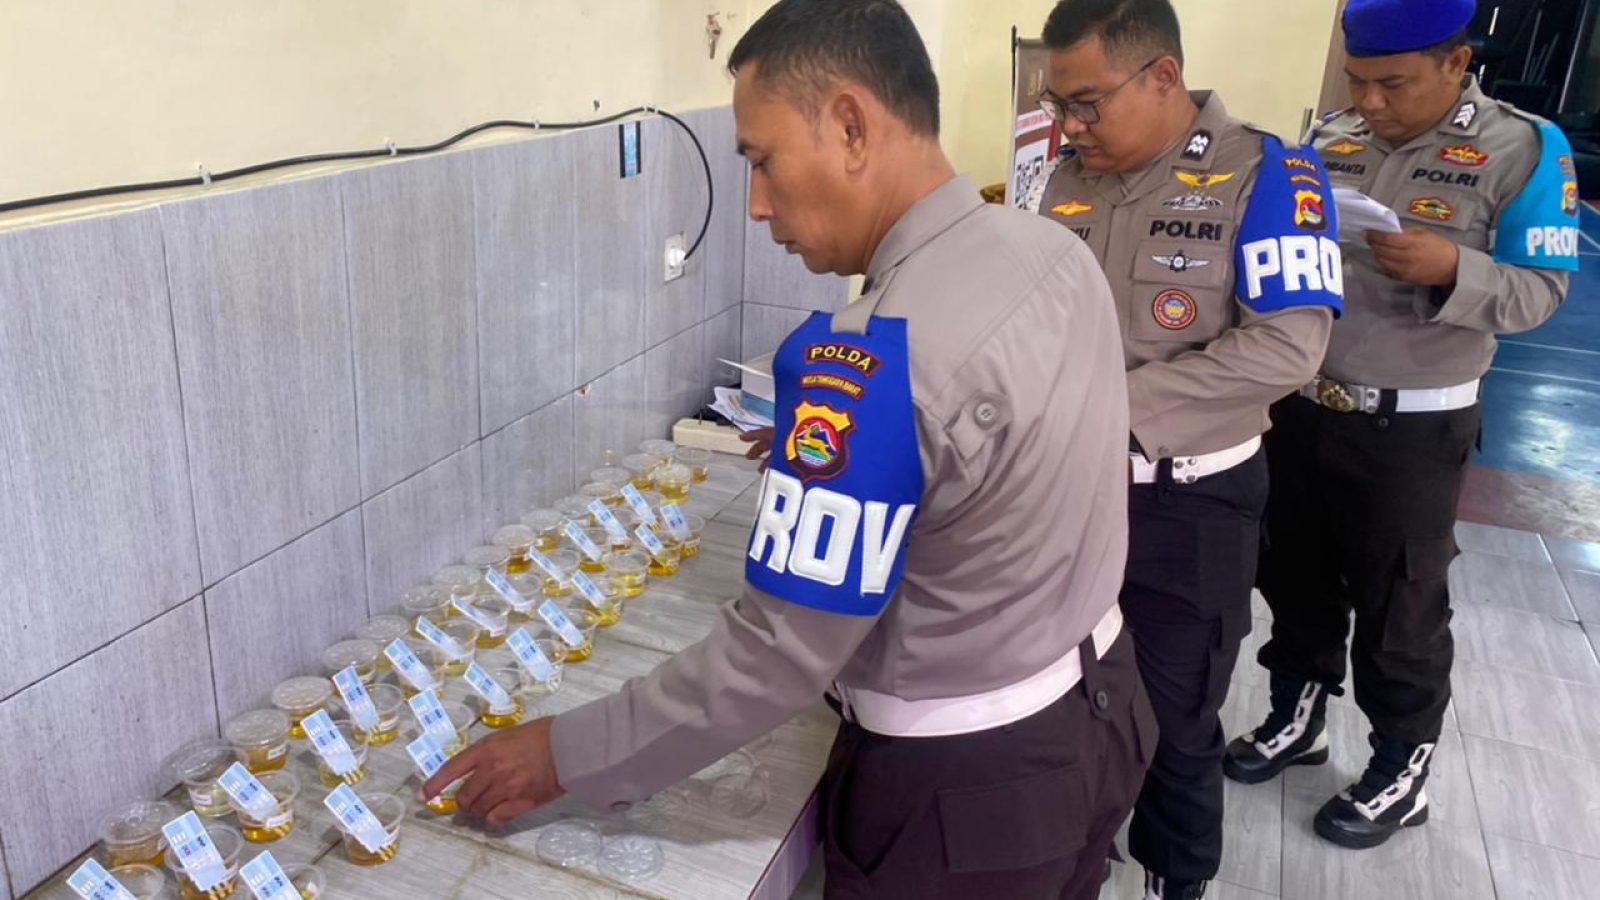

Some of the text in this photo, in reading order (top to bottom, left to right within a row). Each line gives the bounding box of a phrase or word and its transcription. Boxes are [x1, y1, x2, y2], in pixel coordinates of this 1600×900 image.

[1412, 168, 1480, 188] POLRI
[1149, 219, 1223, 241] POLRI
[1526, 226, 1579, 257] PRO
[811, 345, 872, 371] POLDA
[748, 468, 917, 597] ROV
